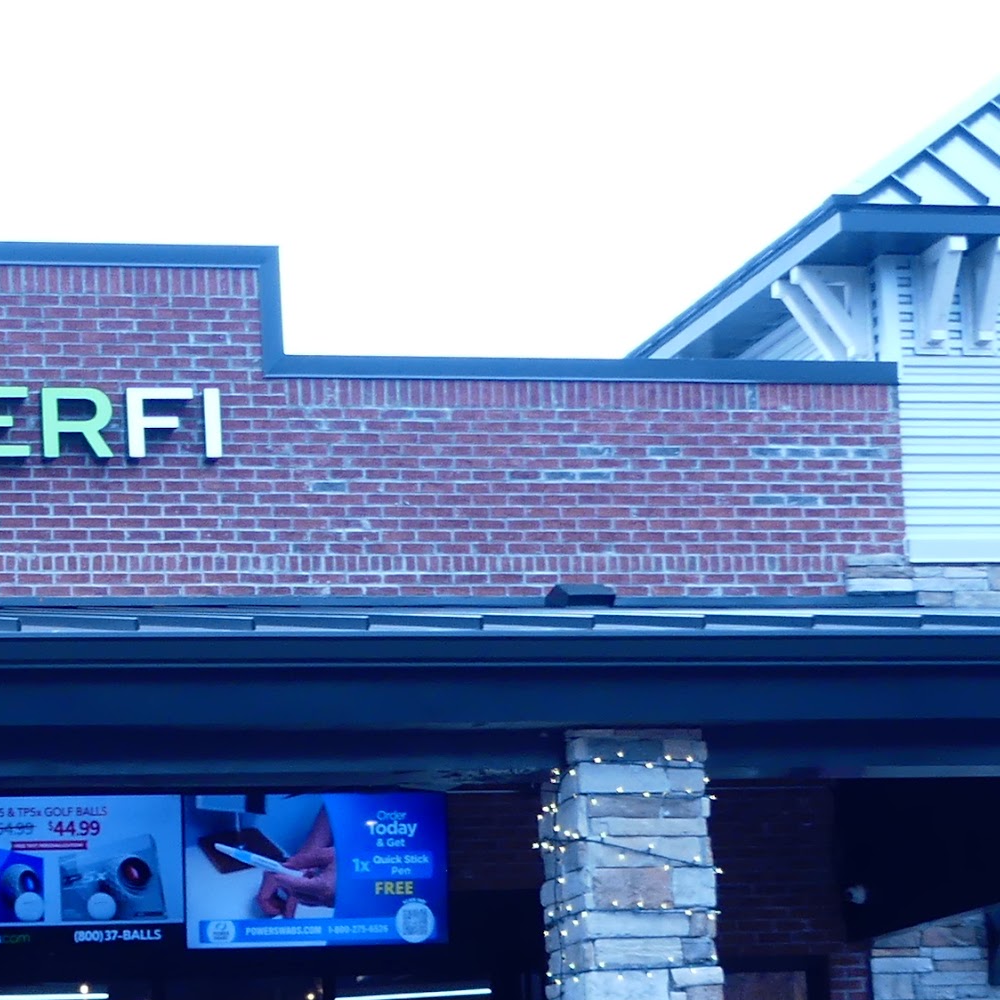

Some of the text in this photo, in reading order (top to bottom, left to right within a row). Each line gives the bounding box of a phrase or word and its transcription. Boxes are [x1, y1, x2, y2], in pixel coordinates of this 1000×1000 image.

[44, 807, 74, 818] GOLF
[76, 807, 108, 817] BALLS
[376, 810, 407, 821] Order
[48, 820, 101, 837] $44.99
[366, 820, 417, 838] Today
[376, 838, 406, 847] & Get
[373, 854, 429, 865] Quick Stick
[352, 859, 371, 873] 1x
[391, 866, 411, 876] Pen
[375, 881, 414, 895] FREE
